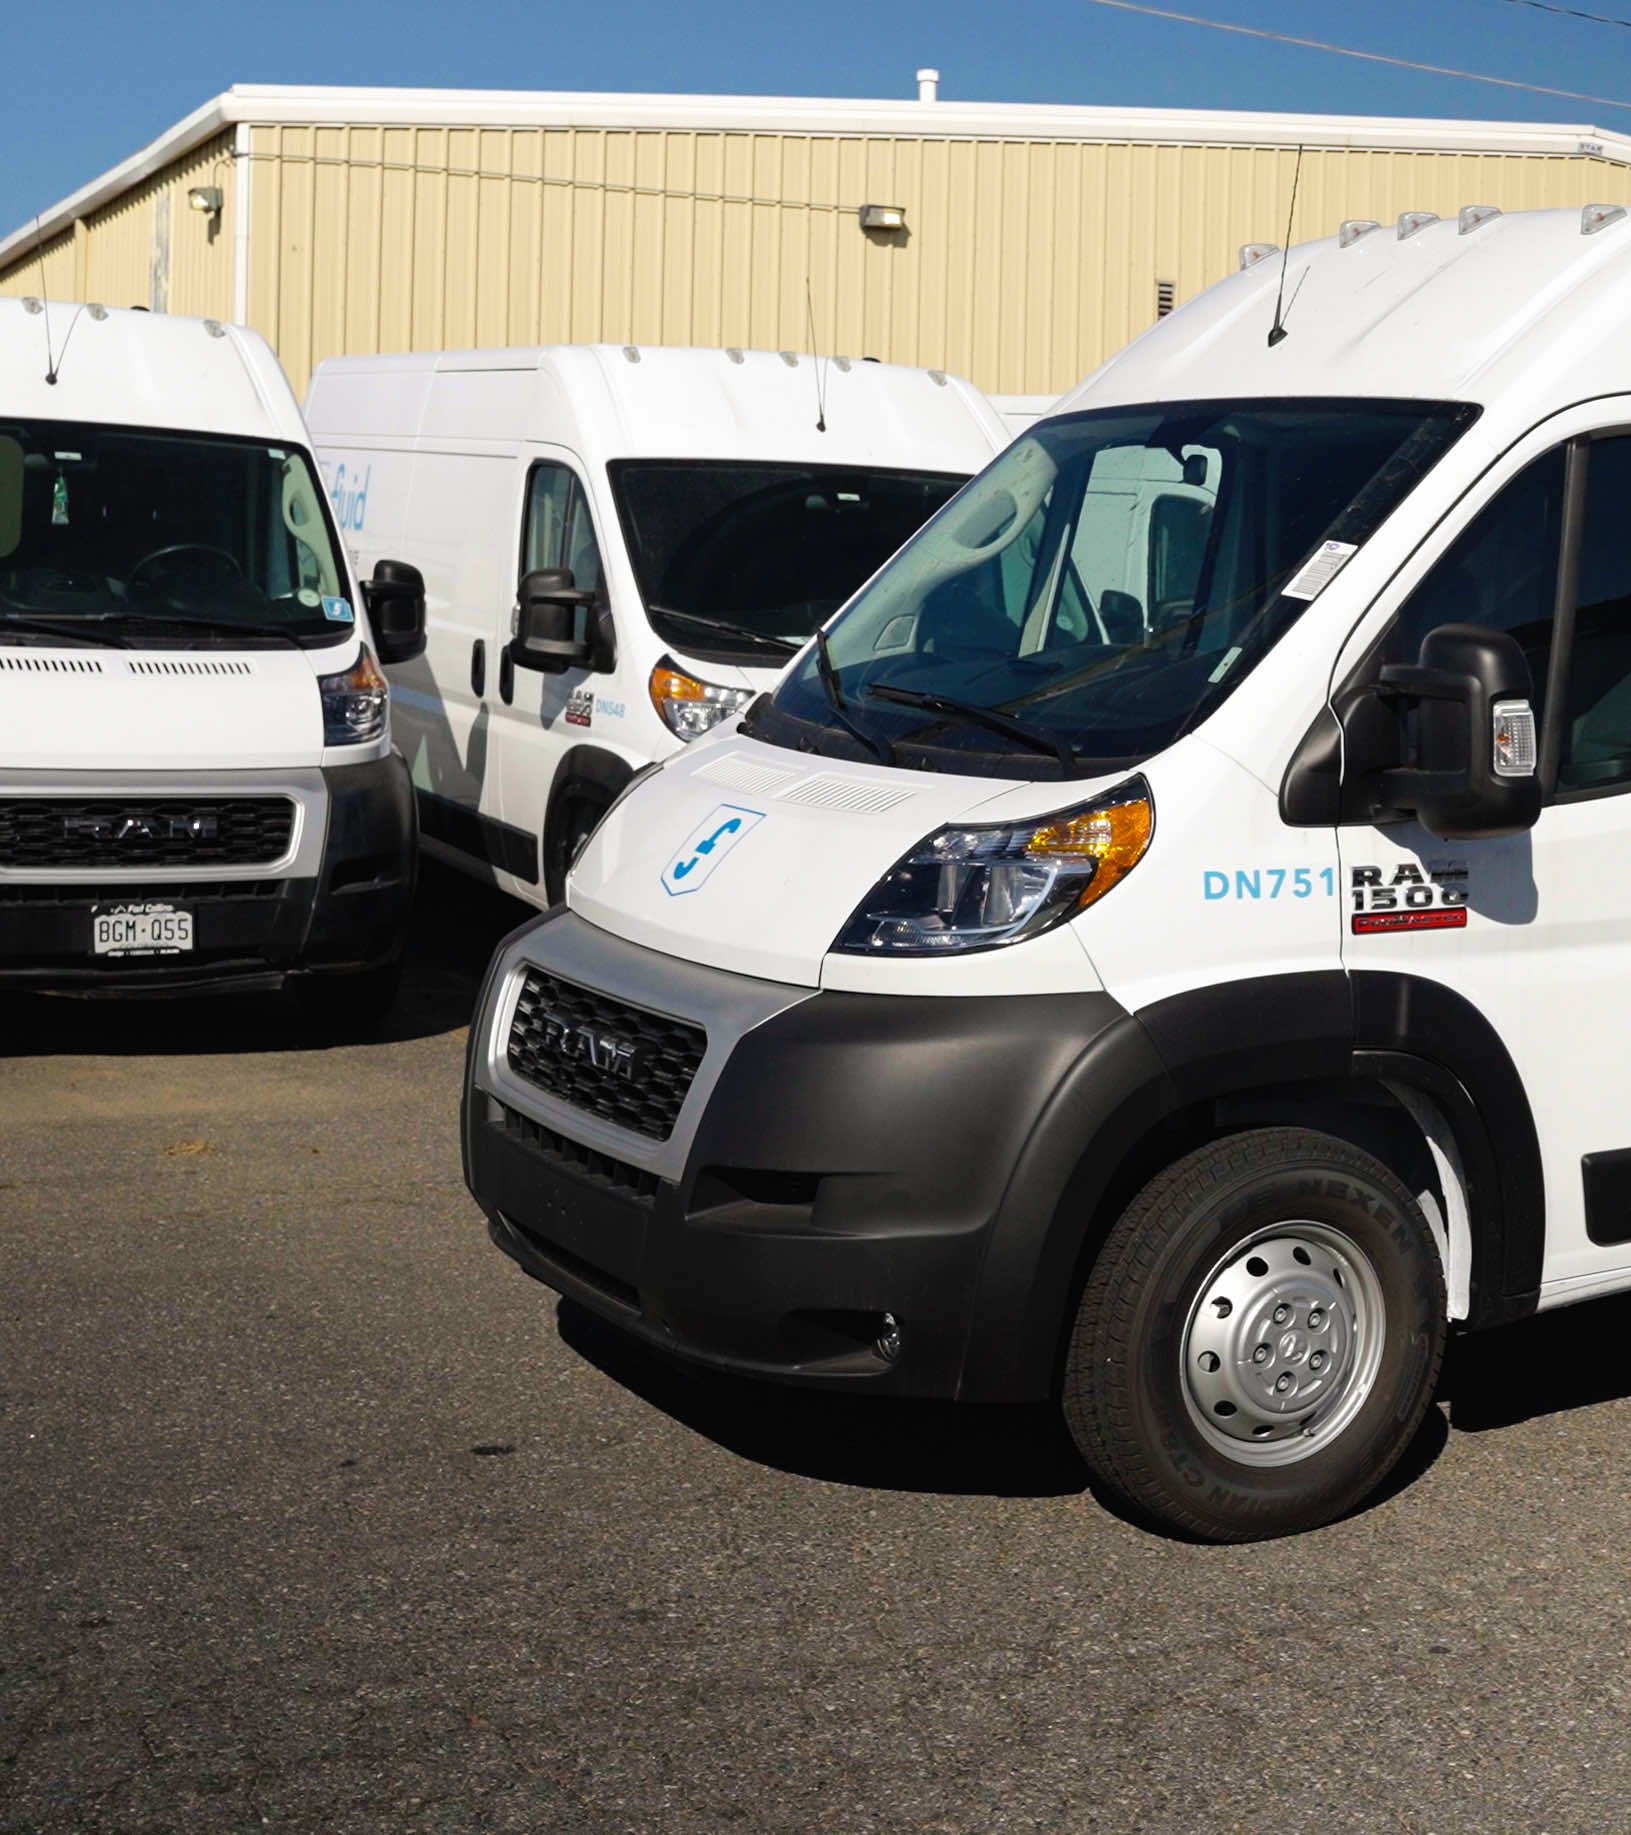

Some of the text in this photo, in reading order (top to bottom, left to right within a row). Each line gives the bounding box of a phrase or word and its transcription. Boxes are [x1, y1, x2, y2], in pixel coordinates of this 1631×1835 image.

[1203, 867, 1334, 900] DN751
[1351, 863, 1470, 888] RAM
[1351, 882, 1470, 911] 1500
